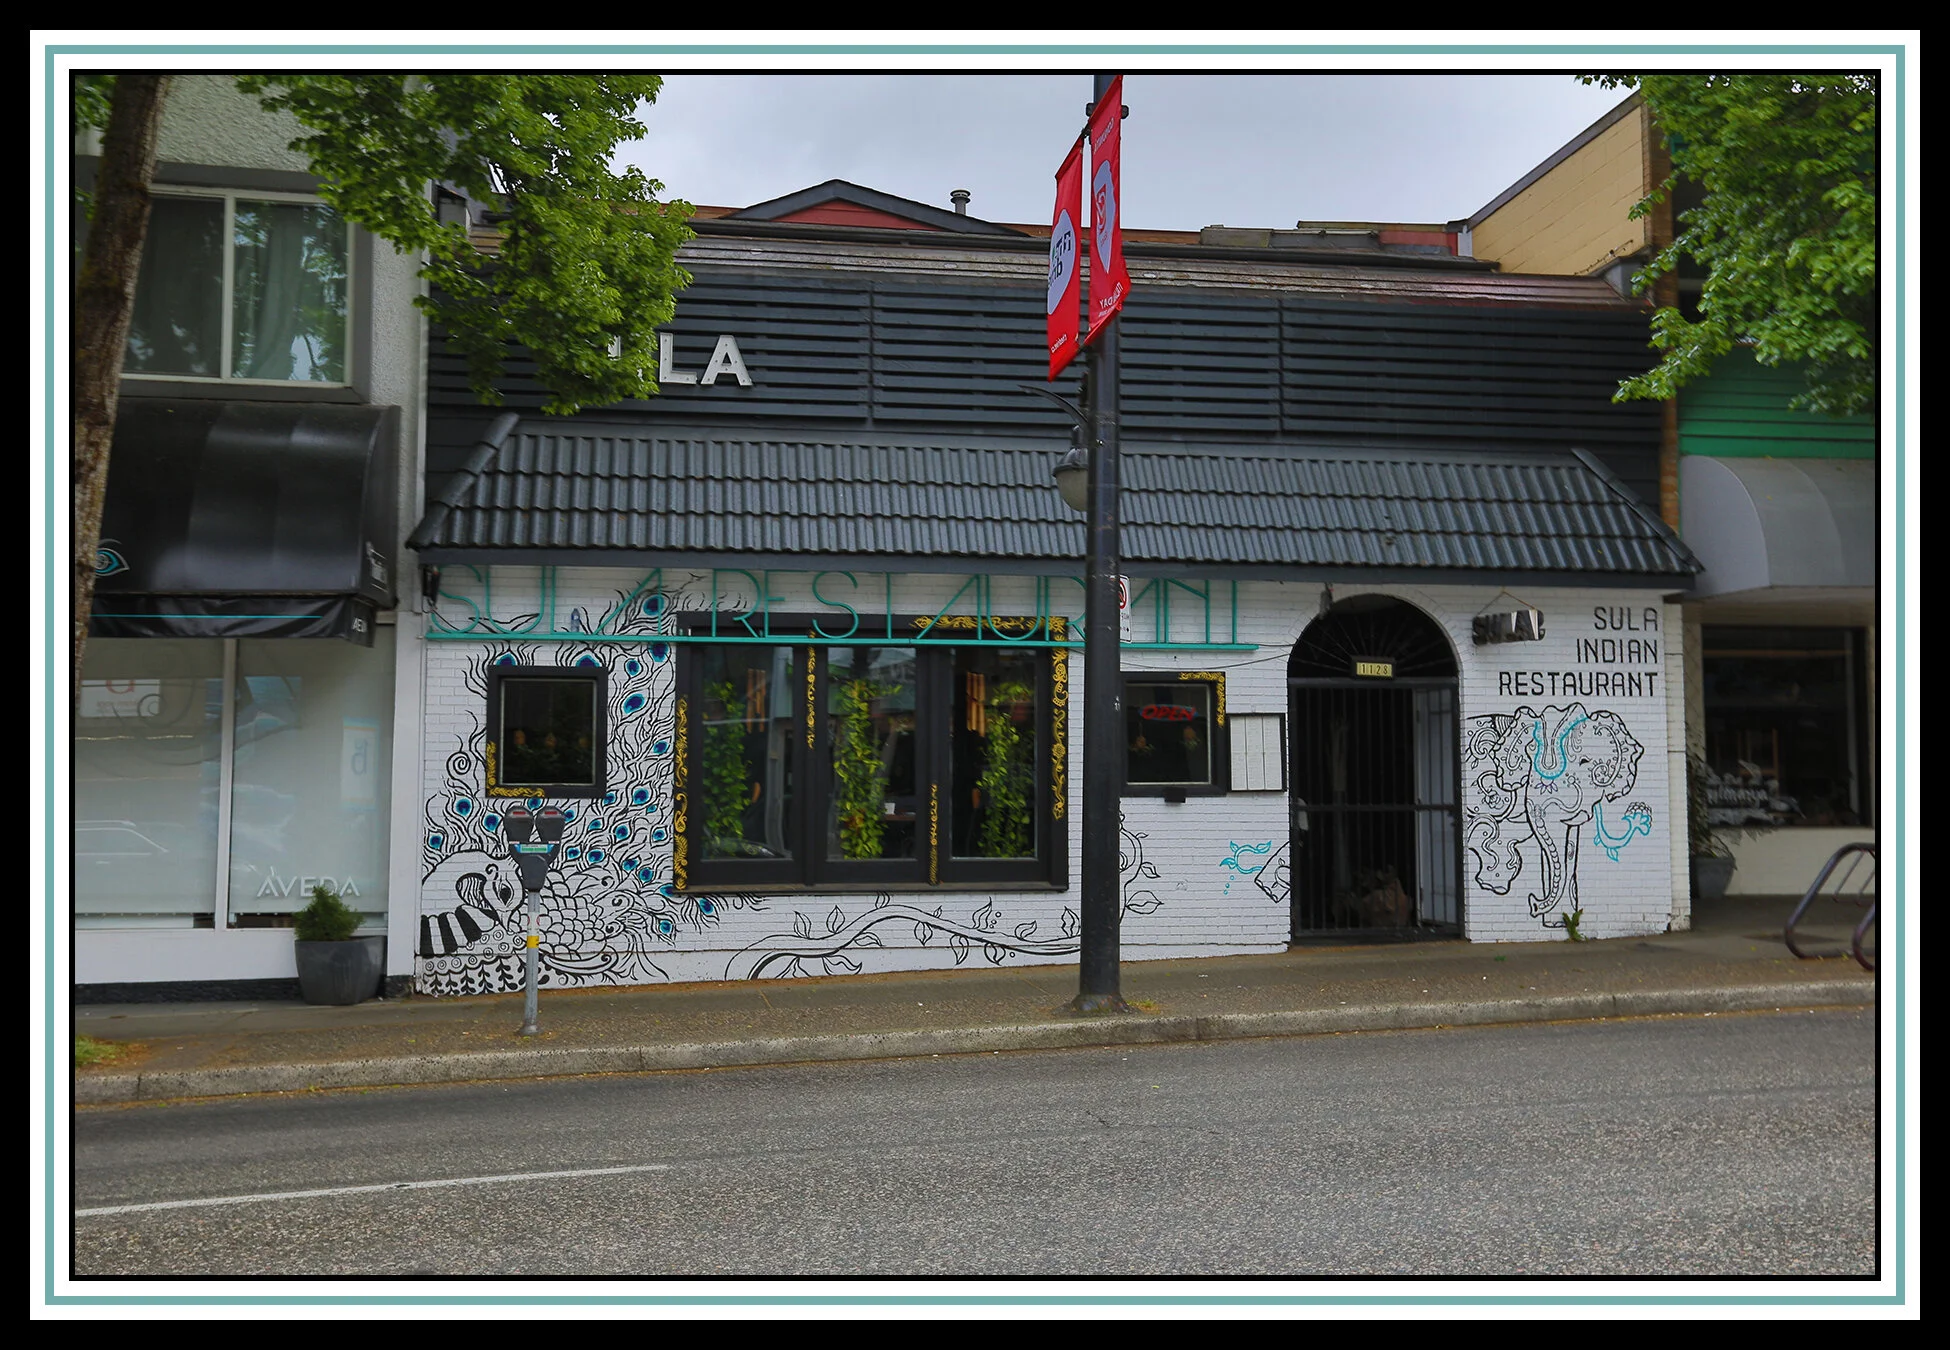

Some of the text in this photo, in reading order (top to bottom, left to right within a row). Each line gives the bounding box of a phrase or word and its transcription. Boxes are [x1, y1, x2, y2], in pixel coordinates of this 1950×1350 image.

[431, 563, 662, 636] SULA
[1594, 606, 1658, 632] SULA
[1576, 638, 1658, 664] INDIAN
[1361, 663, 1388, 675] 1128
[1499, 671, 1658, 697] RESTAURANT
[1141, 704, 1197, 721] OPEN
